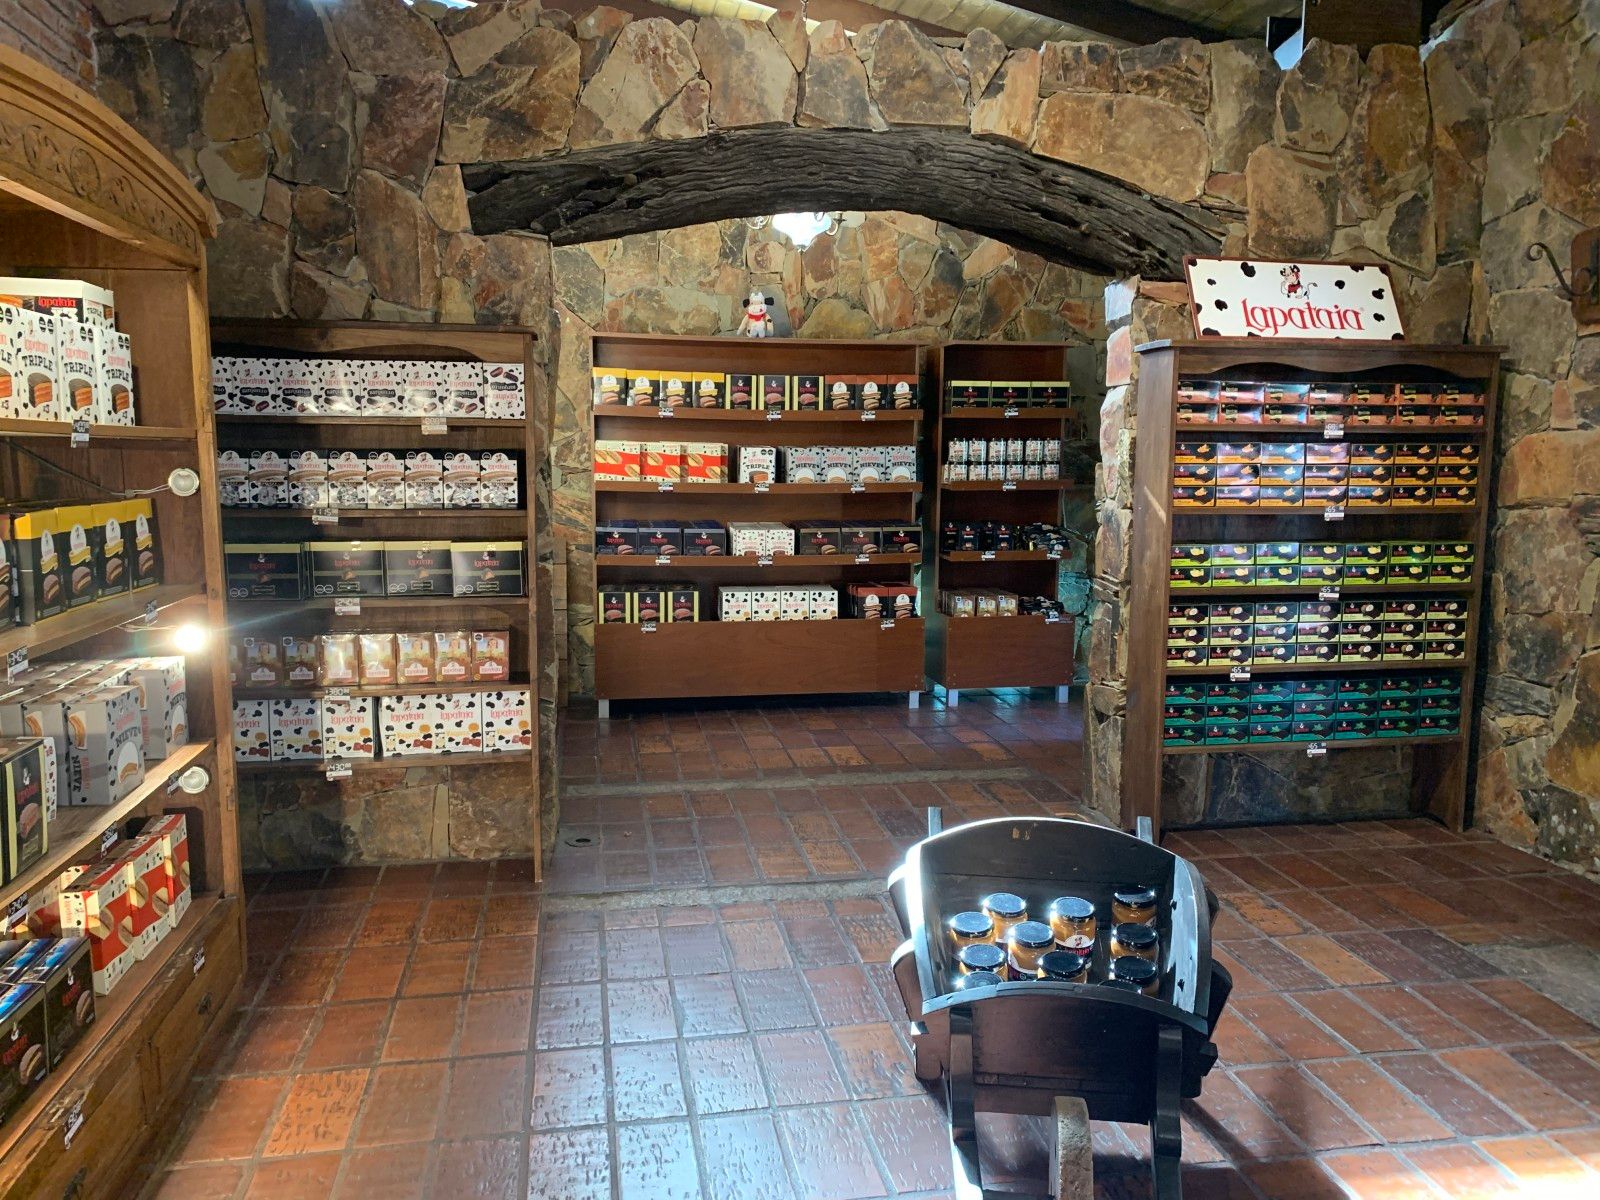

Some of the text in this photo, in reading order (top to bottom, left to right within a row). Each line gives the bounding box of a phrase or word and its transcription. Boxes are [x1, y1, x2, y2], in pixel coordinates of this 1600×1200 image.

[22, 354, 53, 371] TRIPLE
[64, 361, 93, 378] TRIPLE
[105, 368, 130, 383] TRIPLE
[116, 726, 138, 748] NIEVE
